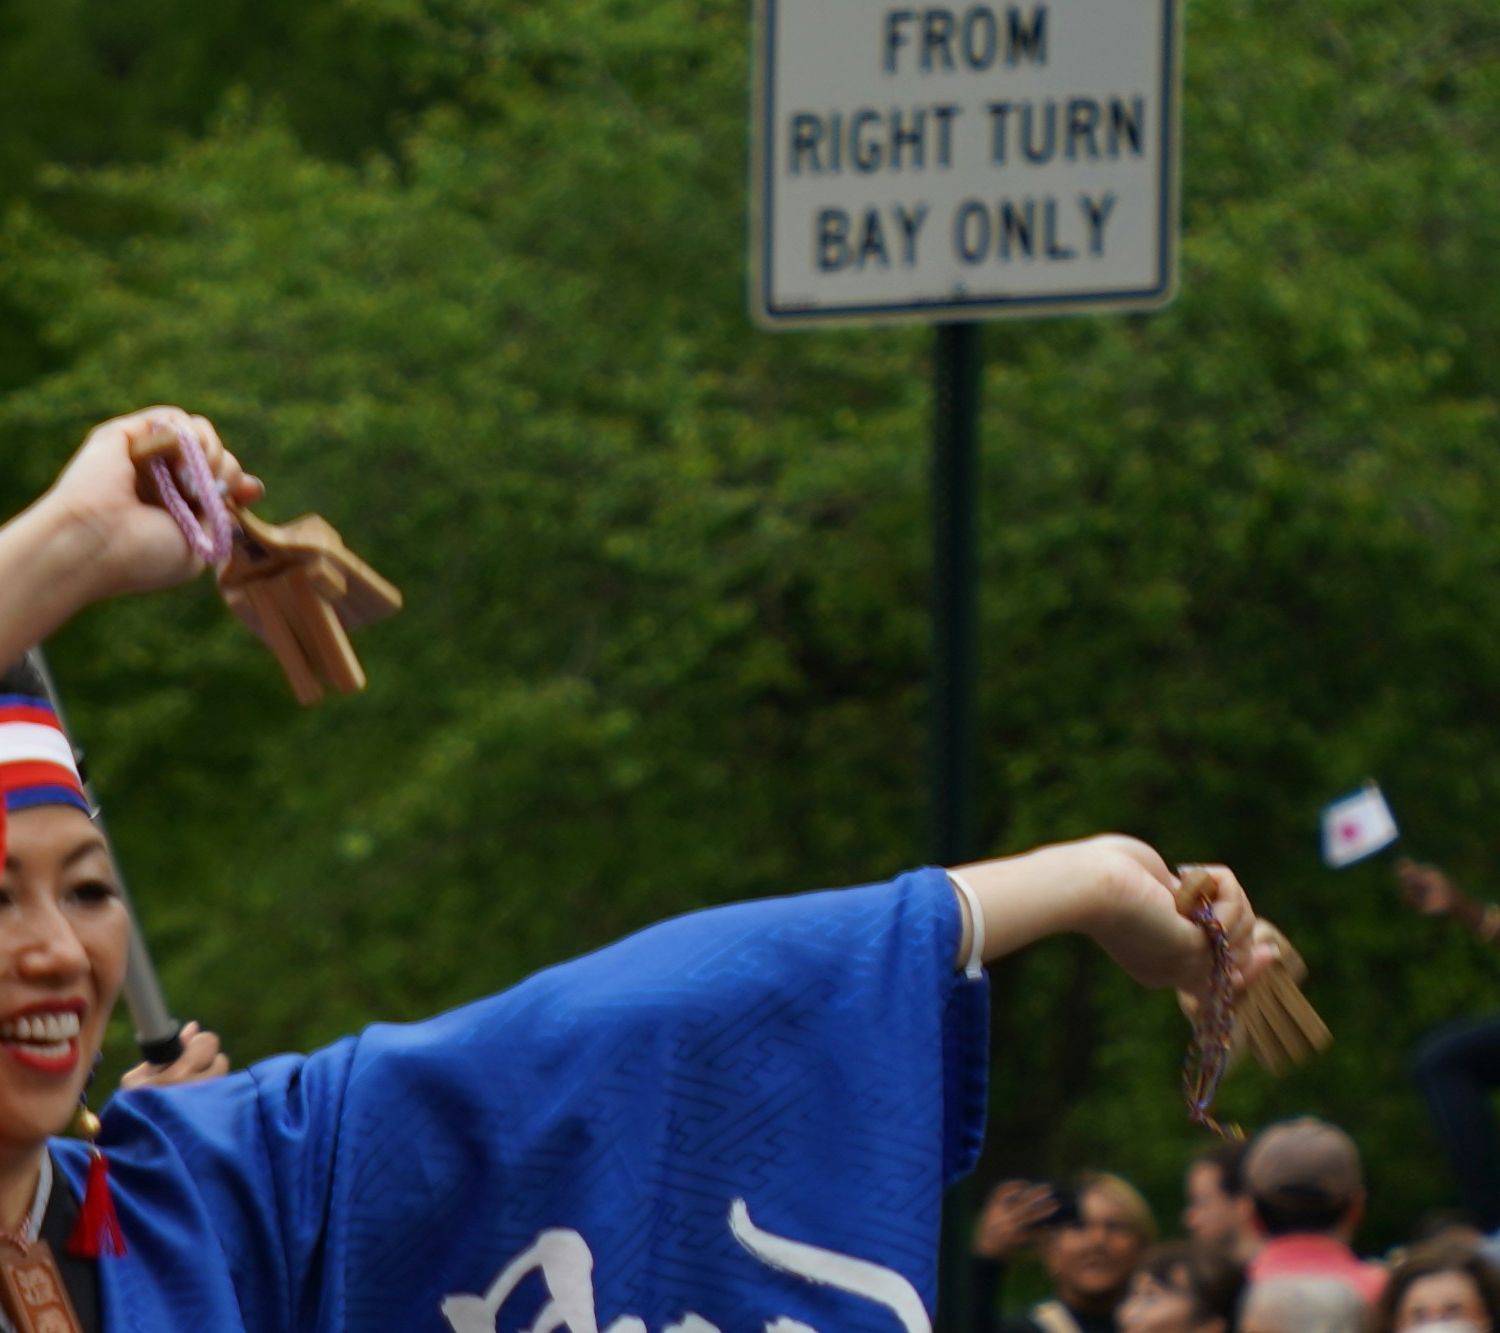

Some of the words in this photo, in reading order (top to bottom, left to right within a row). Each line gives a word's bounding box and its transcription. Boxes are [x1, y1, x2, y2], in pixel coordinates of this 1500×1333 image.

[884, 5, 1048, 73] FROM
[788, 105, 960, 175] RIGHT
[988, 96, 1145, 166] TURN
[816, 204, 929, 273] BAY
[955, 194, 1118, 265] ONLY
